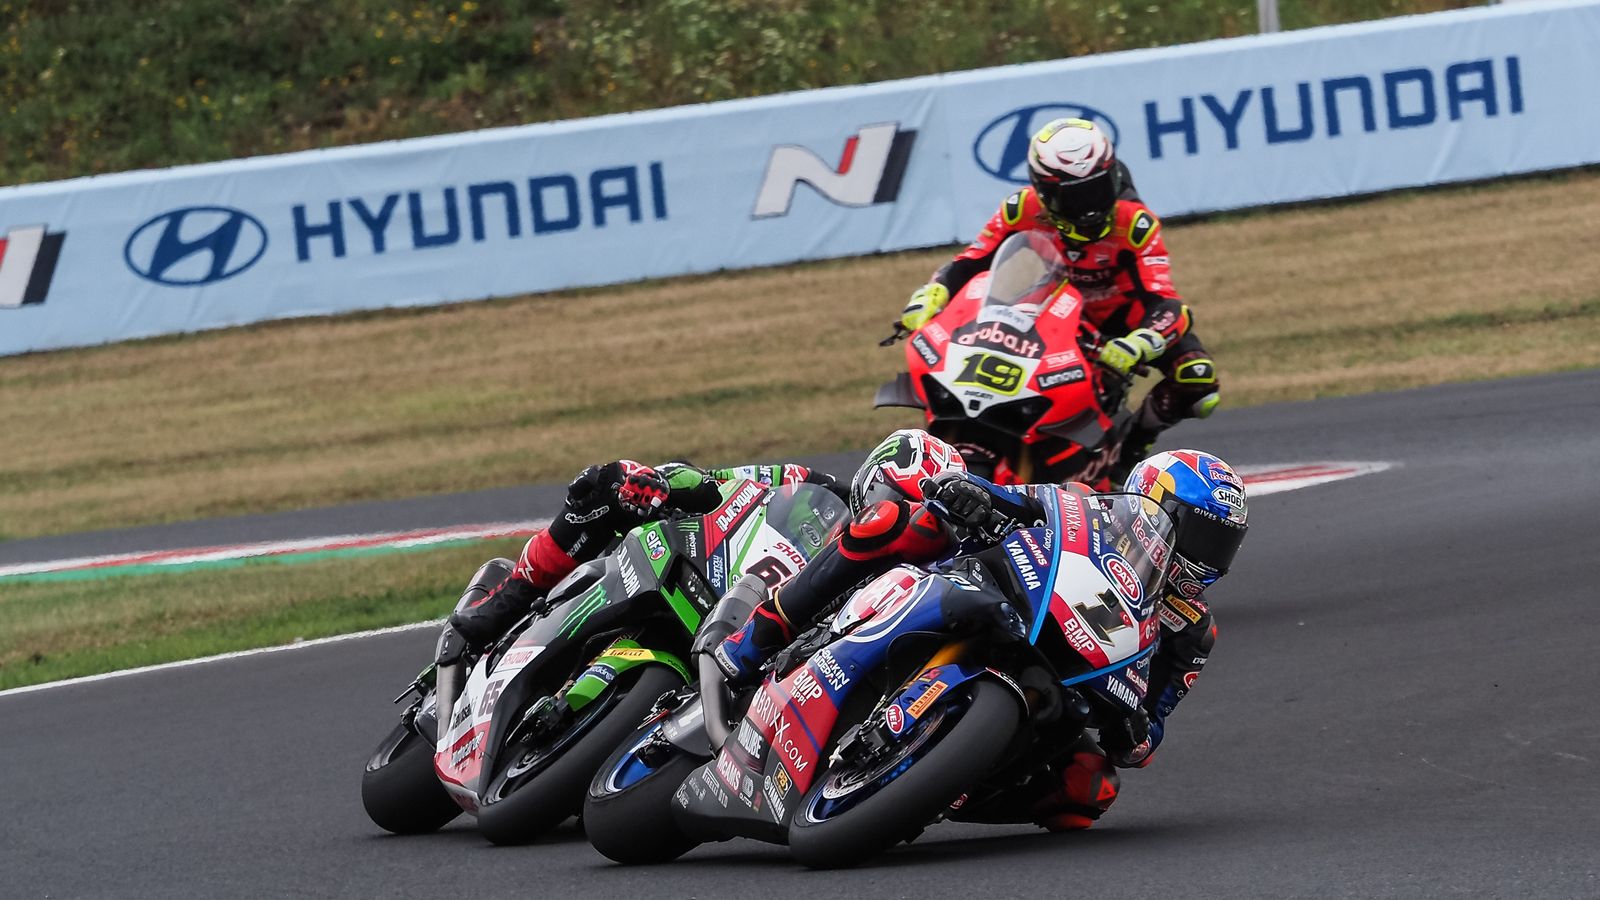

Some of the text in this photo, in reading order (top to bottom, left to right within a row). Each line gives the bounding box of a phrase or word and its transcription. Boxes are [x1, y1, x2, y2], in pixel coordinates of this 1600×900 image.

[1145, 56, 1525, 159] HYUNDAI
[292, 161, 669, 262] HYUNDAI
[912, 333, 938, 365] Lenovo
[958, 322, 1042, 358] aruba.it
[953, 352, 1026, 396] 19
[1037, 368, 1085, 388] Lenovo
[1194, 507, 1217, 521] GIVES
[1220, 518, 1235, 528] YOU
[647, 530, 662, 550] elf
[1020, 530, 1048, 566] McAMS
[1006, 540, 1041, 591] YAMAHA
[1112, 563, 1137, 596] PATA
[1072, 589, 1134, 648] 1
[1160, 607, 1183, 626] YAMAHA
[1064, 618, 1095, 651] BMP
[478, 679, 505, 718] 65
[789, 686, 807, 706] TAPPI
[793, 669, 823, 699] BMP
[911, 683, 944, 715] PIRELLI
[1106, 675, 1139, 711] YAMAHA
[888, 708, 898, 729] HEL
[717, 749, 741, 791] McAMS
[766, 781, 786, 821] YAMAHA
